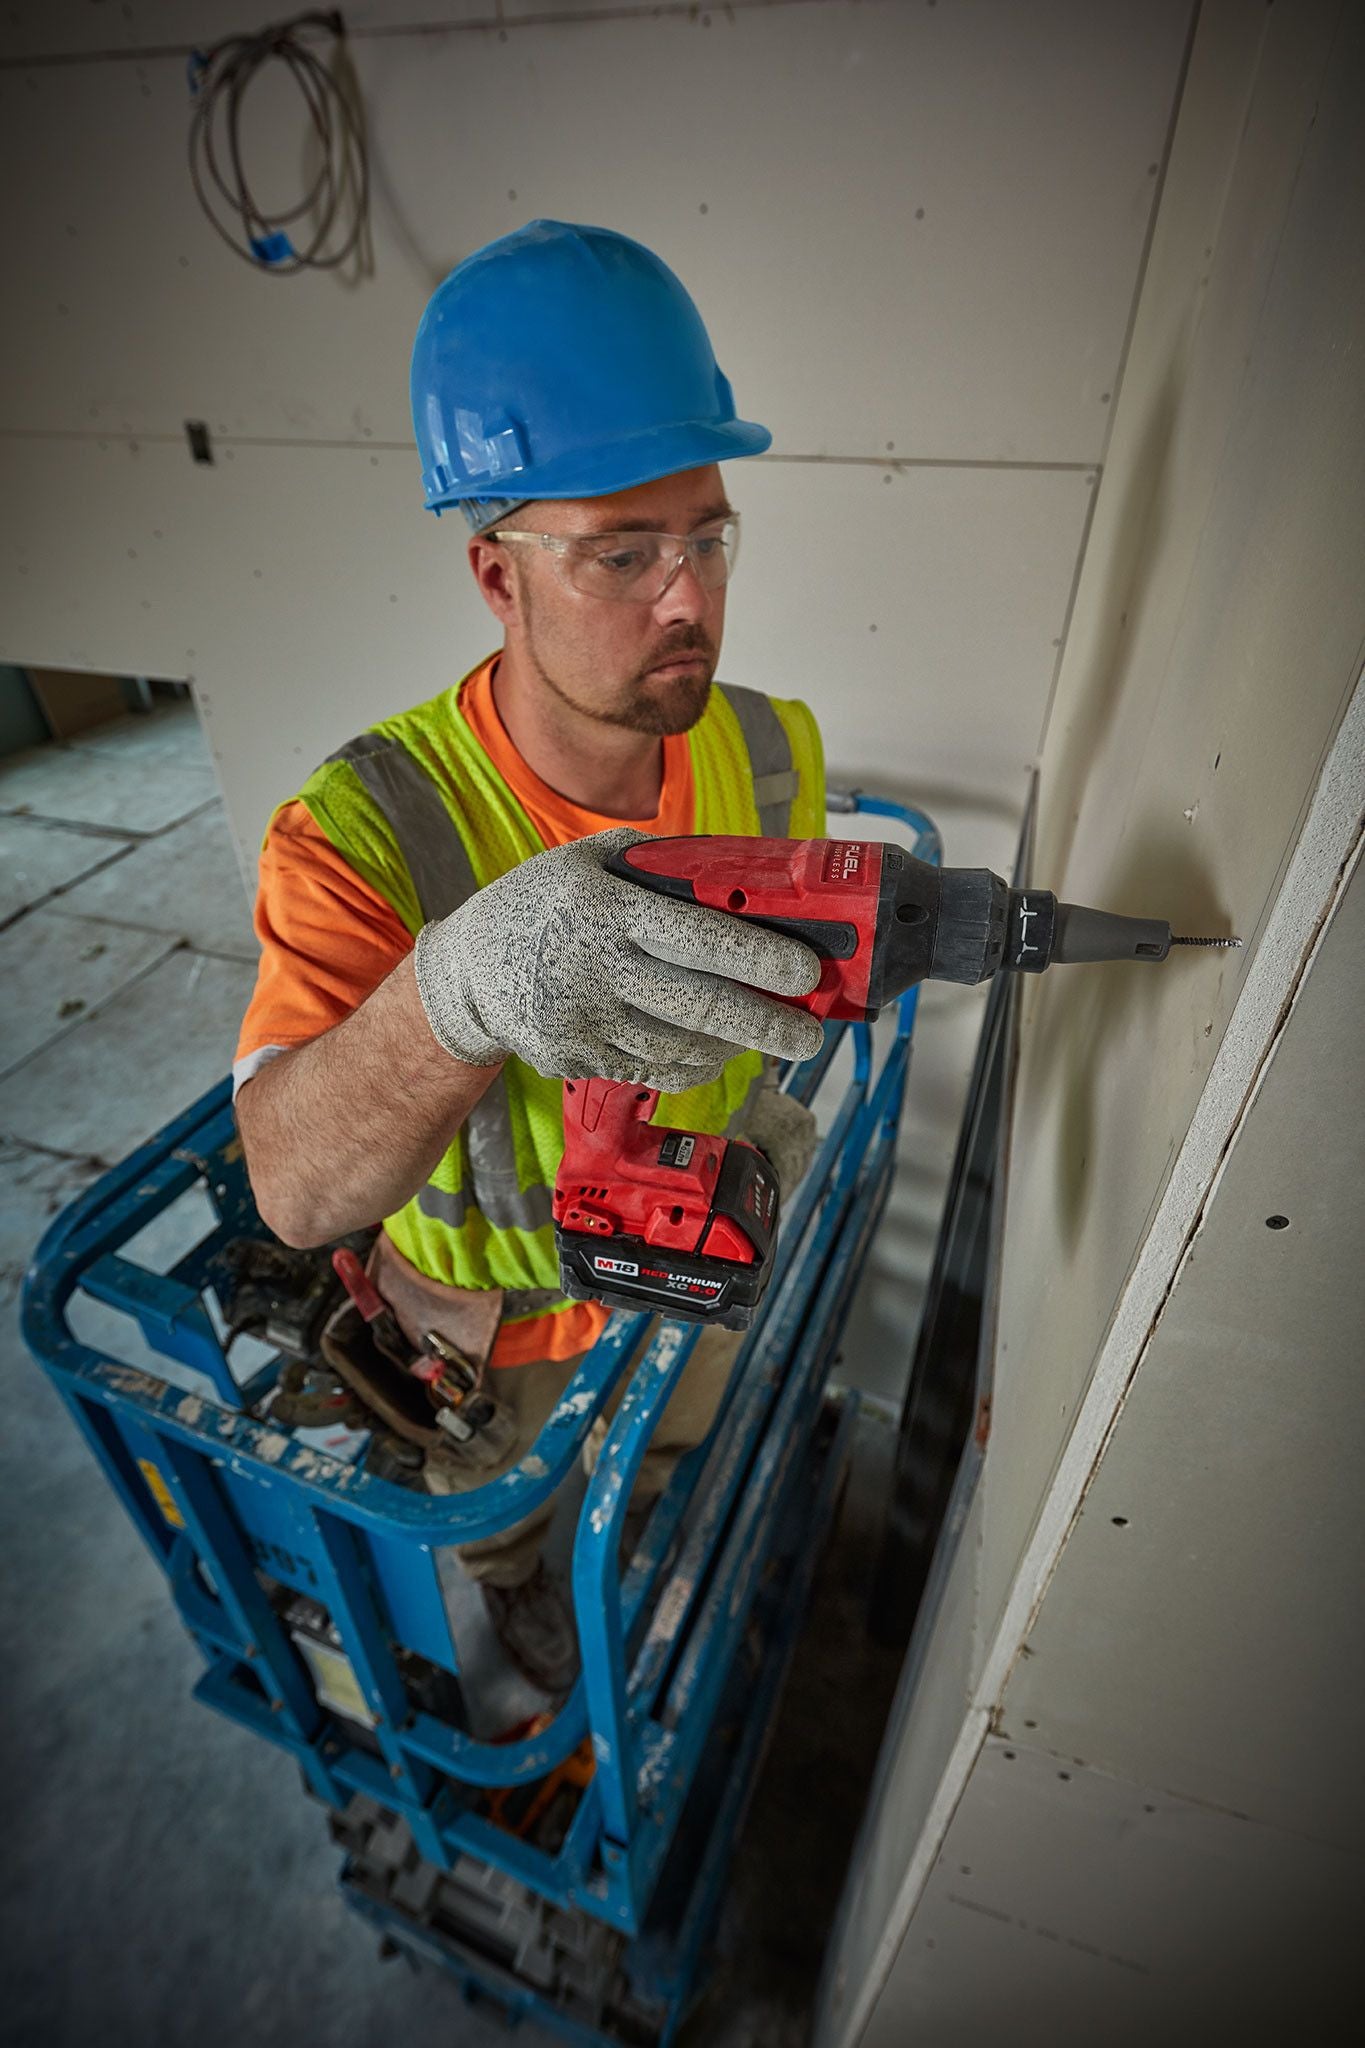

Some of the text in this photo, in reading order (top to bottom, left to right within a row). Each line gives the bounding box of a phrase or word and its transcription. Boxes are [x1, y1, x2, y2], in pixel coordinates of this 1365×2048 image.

[843, 844, 860, 879] FUEL
[597, 1259, 722, 1289] M18 REDLITHIUM
